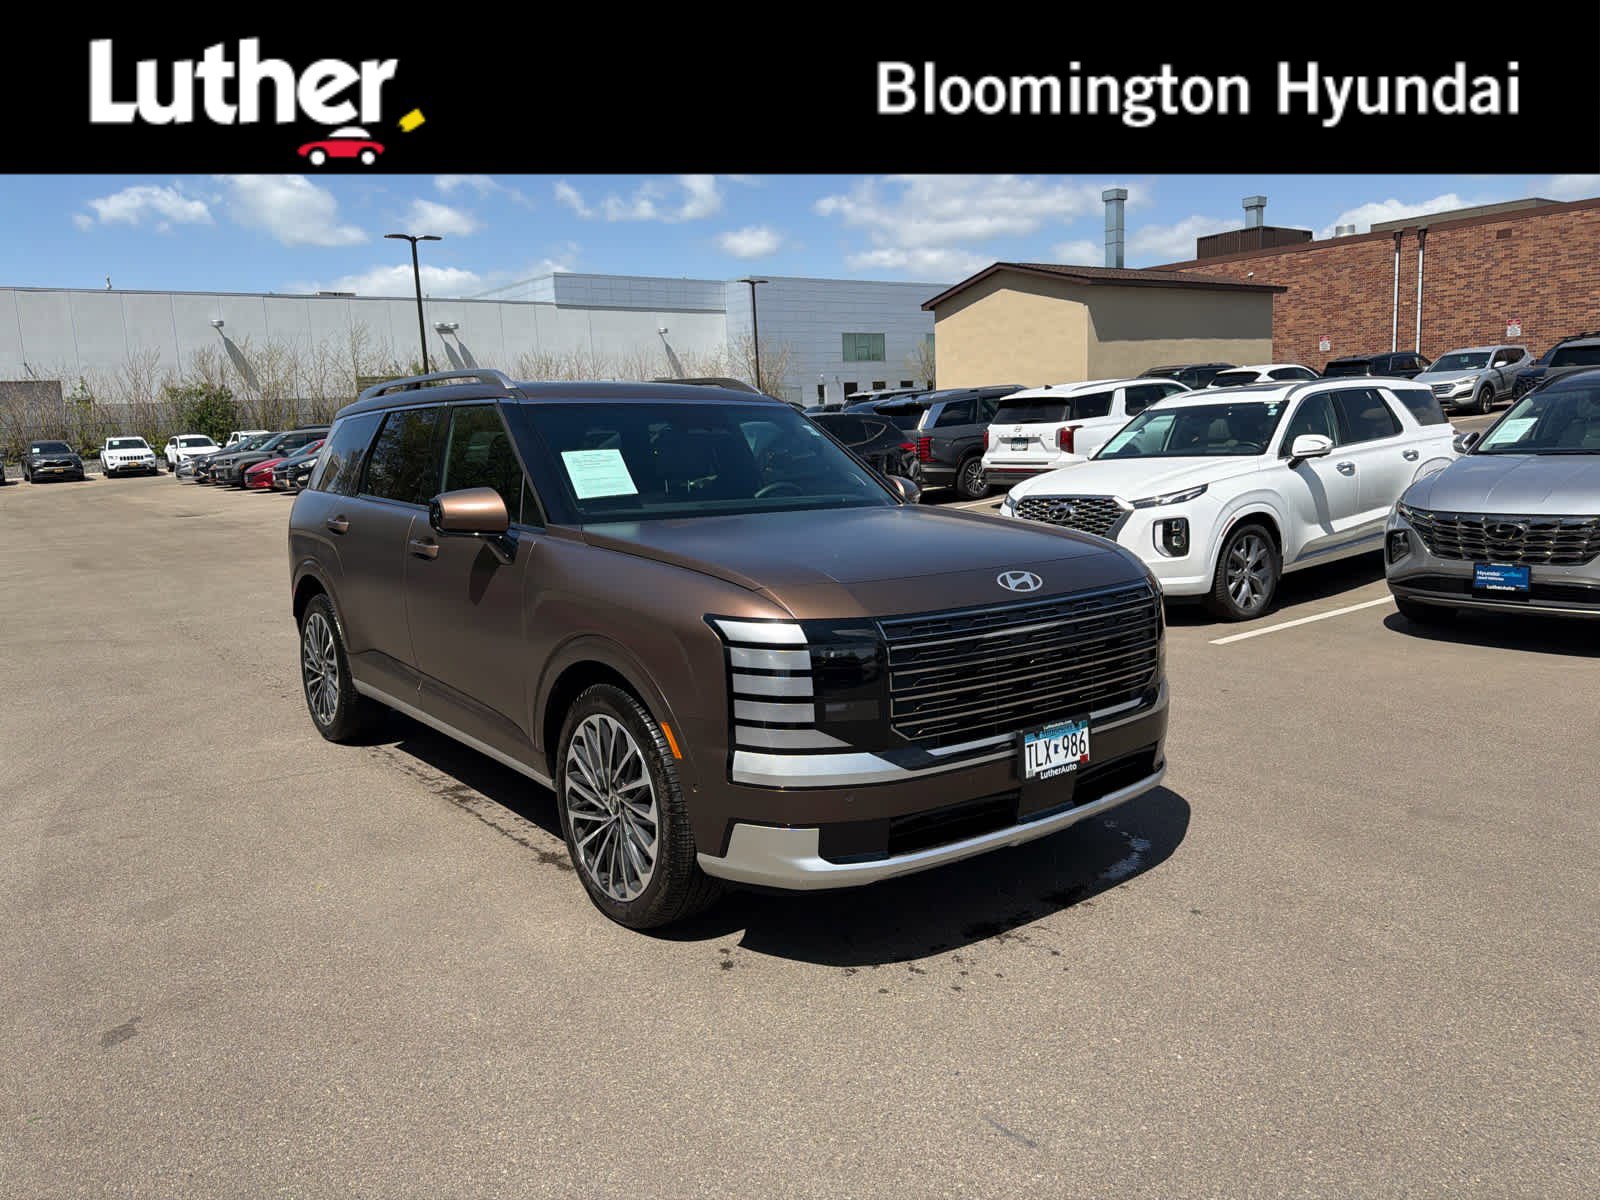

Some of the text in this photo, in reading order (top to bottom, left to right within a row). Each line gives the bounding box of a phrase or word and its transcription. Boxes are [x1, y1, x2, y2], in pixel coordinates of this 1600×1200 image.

[1026, 731, 1087, 769] TLX 986
[1040, 763, 1078, 780] LutherAuto
